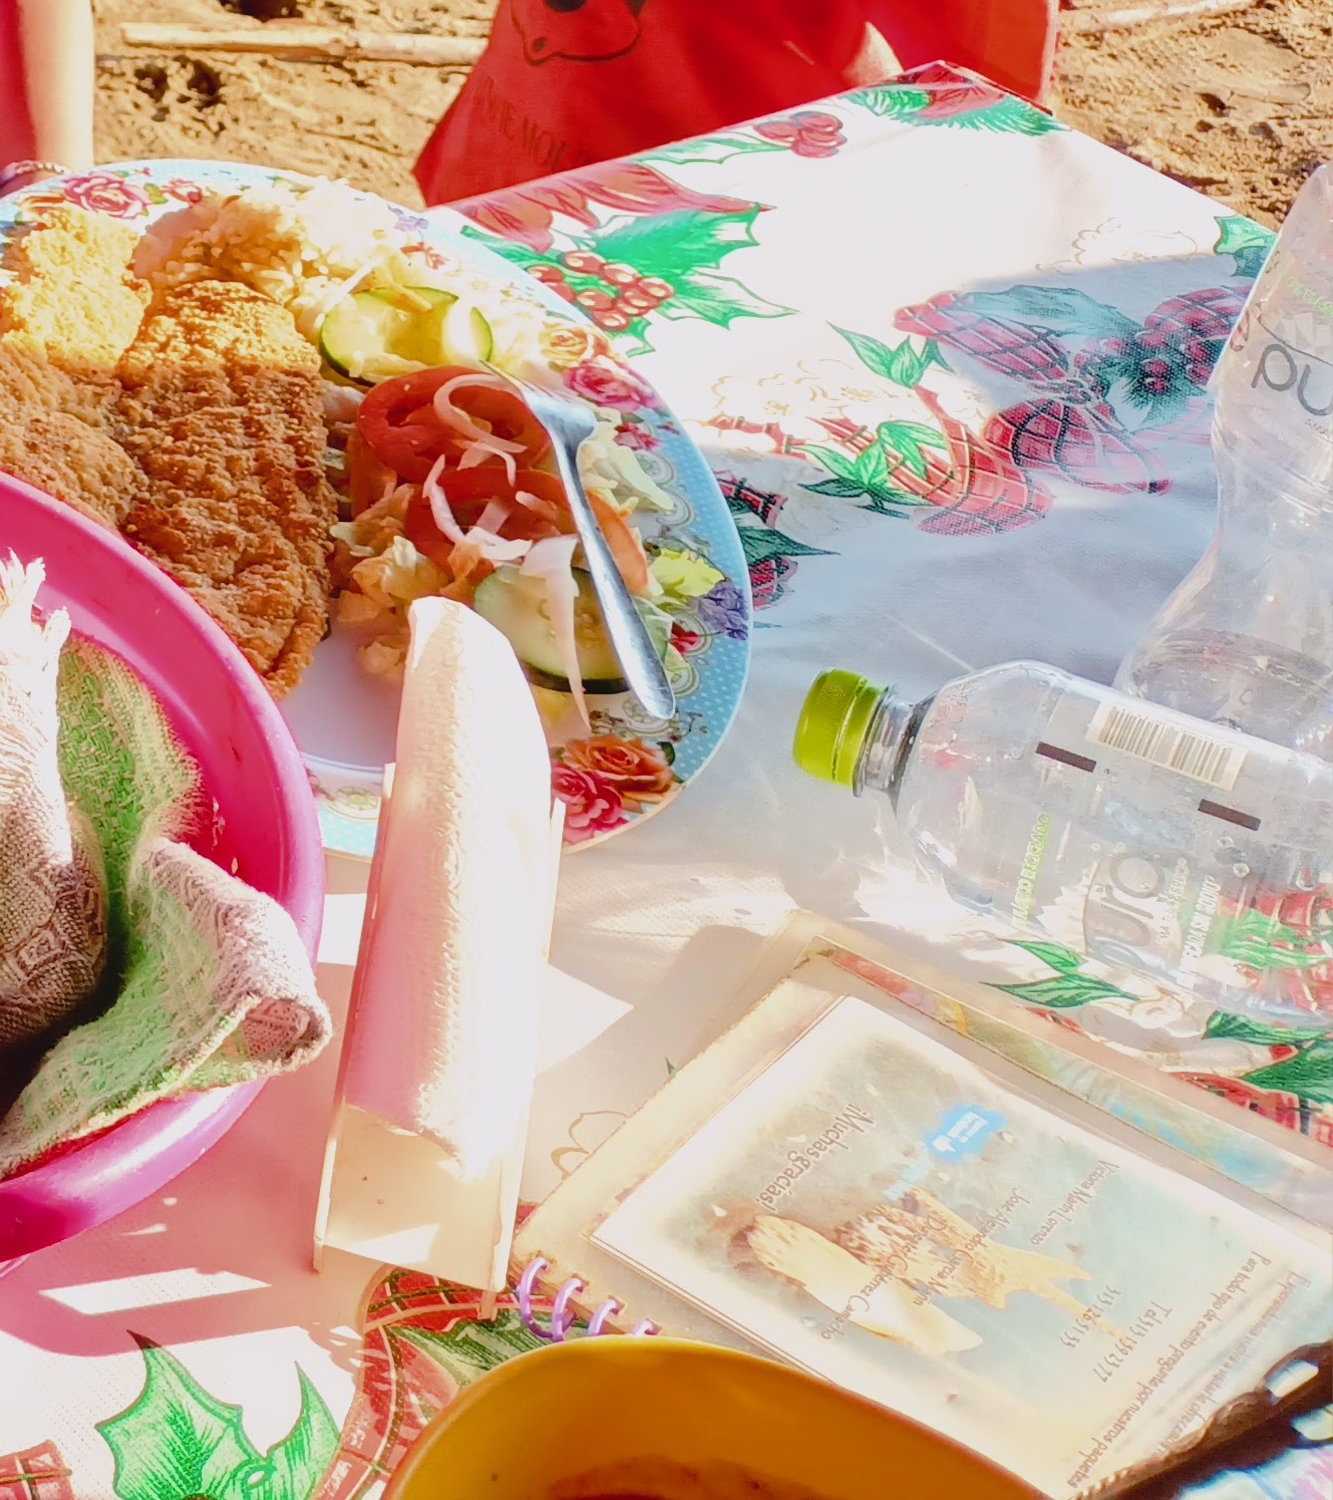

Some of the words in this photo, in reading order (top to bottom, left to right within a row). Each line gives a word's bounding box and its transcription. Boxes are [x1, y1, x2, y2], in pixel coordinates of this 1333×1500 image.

[963, 1207, 1012, 1251] Alejandro
[1028, 1214, 1072, 1247] Lorenzo
[1240, 1250, 1272, 1274] Para
[1224, 1271, 1251, 1294] todo
[1201, 1307, 1223, 1323] de
[1208, 1290, 1234, 1310] tipo
[819, 1294, 870, 1340] Camacho
[1178, 1319, 1207, 1351] evento
[1147, 1343, 1184, 1388] pregunte
[1133, 1380, 1154, 1407] por
[1101, 1401, 1139, 1444] nuestros
[1065, 1437, 1109, 1489] paquetes
